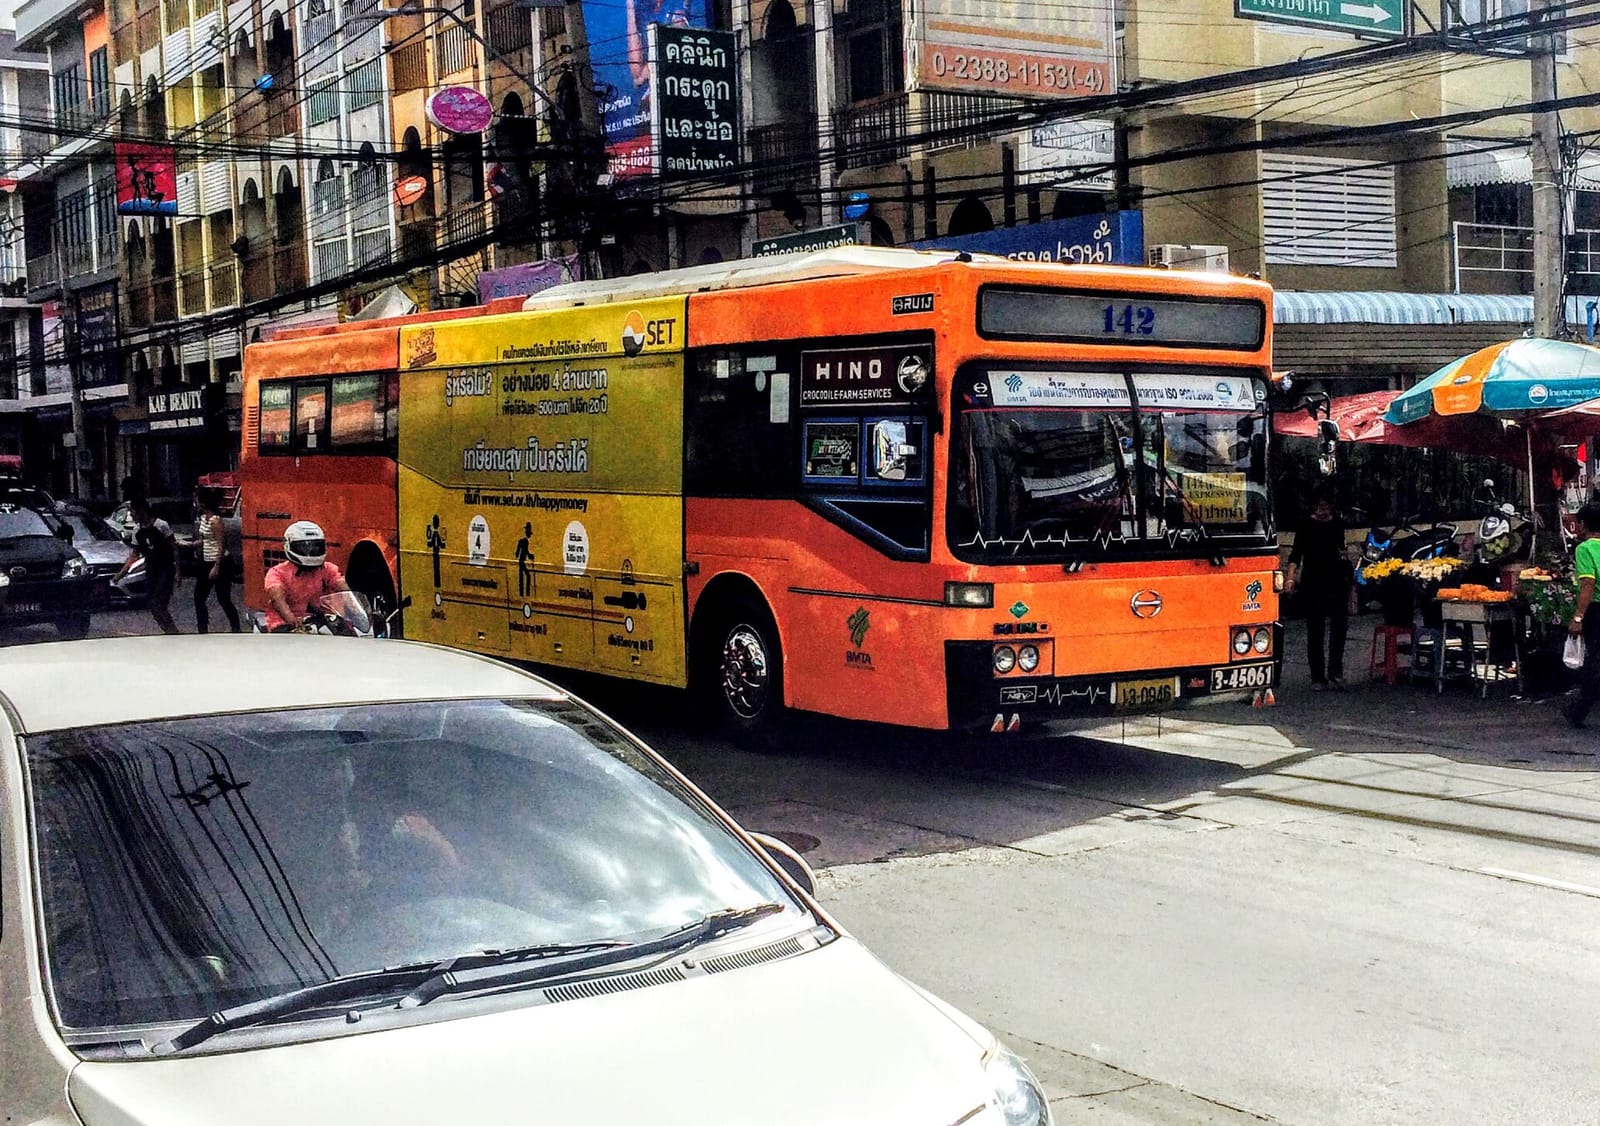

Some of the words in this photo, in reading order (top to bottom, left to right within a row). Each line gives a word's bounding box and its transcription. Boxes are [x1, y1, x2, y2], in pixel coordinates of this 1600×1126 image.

[665, 35, 727, 68] คลินิก
[932, 51, 1104, 92] 0-2388-1153(-4)
[664, 75, 730, 110] กระดูก
[664, 111, 733, 140] และข้อ
[646, 318, 676, 346] SET
[1102, 304, 1155, 335] 142
[502, 368, 550, 393] อย่างน้อย
[551, 370, 560, 392] 4
[562, 362, 608, 392] ล้านบาท
[816, 359, 882, 380] HINO
[169, 390, 202, 411] BEAUTY
[446, 368, 493, 407] รู้หรือไม่?
[1165, 388, 1177, 399] ISO
[538, 399, 553, 415] 500
[463, 438, 522, 482] เกษียณสุข
[525, 435, 588, 472] เป็นจริงได้
[481, 493, 588, 513] www.set.or.th/happymoney
[475, 534, 482, 550] 4
[1214, 665, 1273, 690] 3-45061
